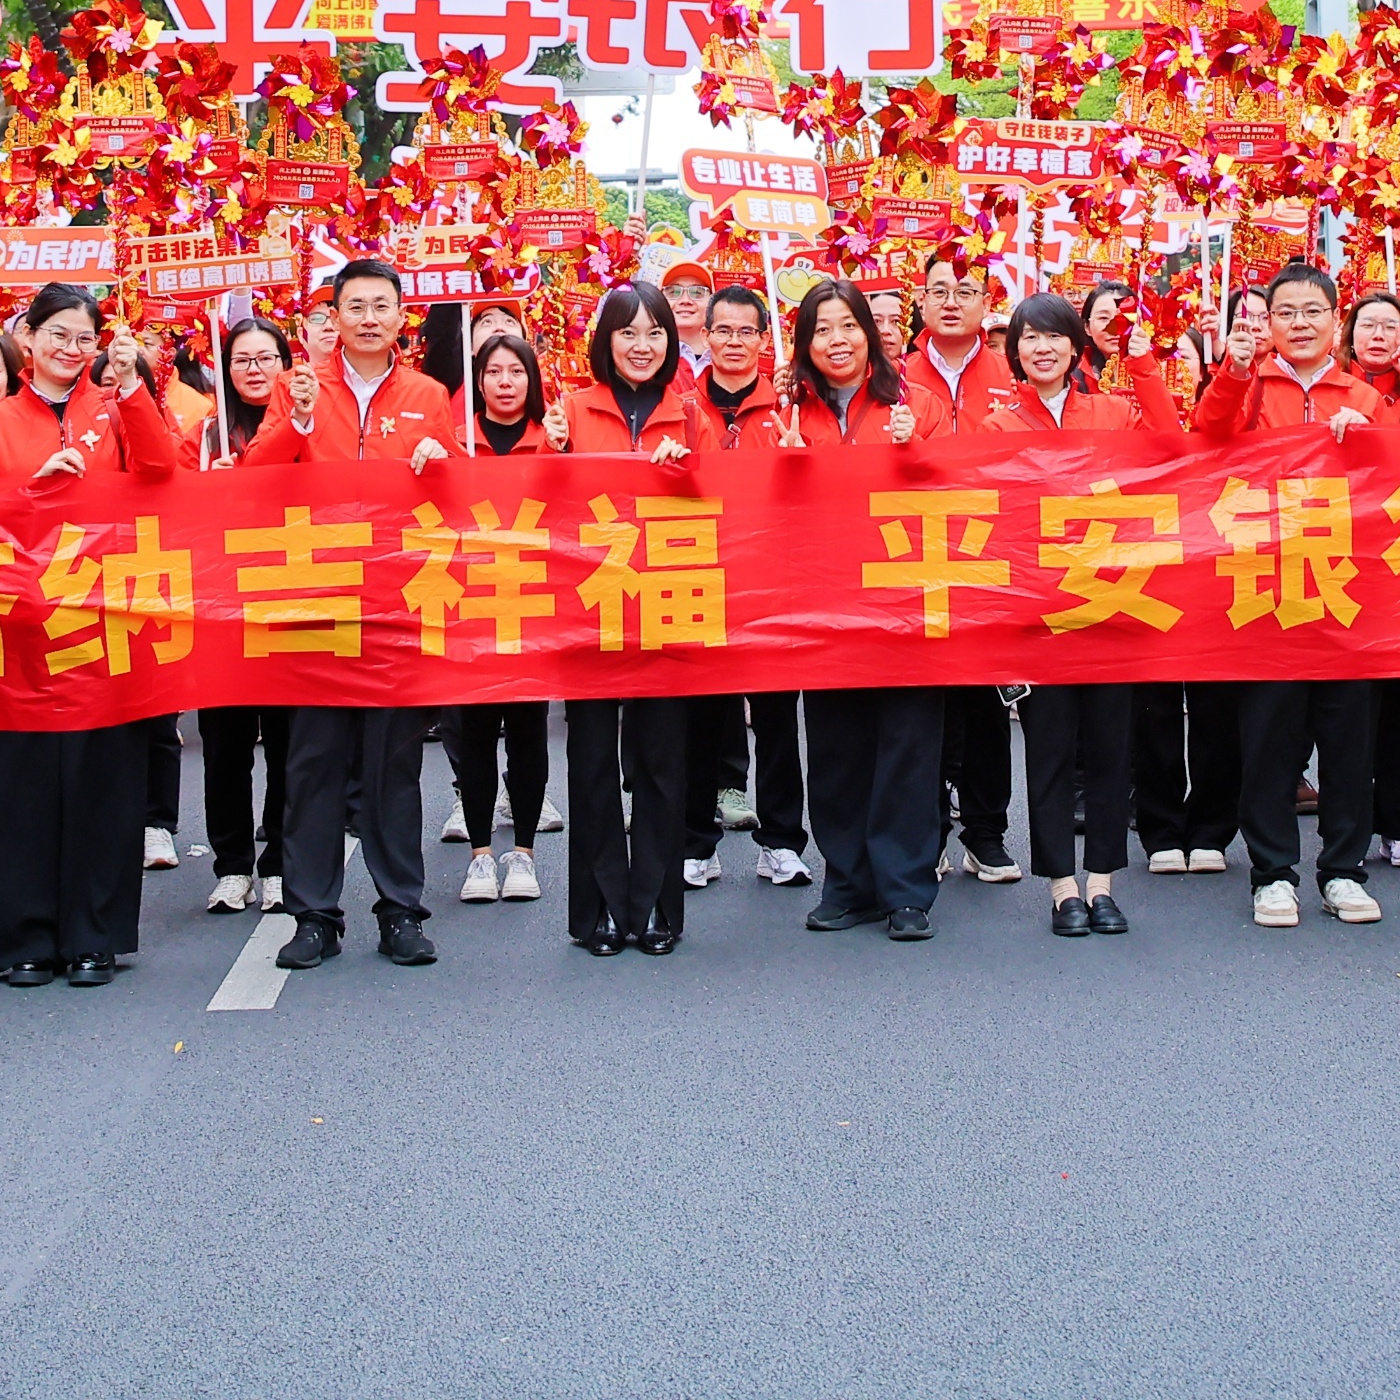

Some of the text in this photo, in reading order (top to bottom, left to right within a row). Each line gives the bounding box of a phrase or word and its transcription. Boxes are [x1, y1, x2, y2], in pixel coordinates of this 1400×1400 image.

[1004, 121, 1086, 143] 守住钱袋子
[691, 155, 818, 194] 专业让生活
[957, 144, 1094, 176] 护好幸福家
[747, 196, 817, 227] 更简单
[155, 258, 294, 292] 拒绝高利诱惑
